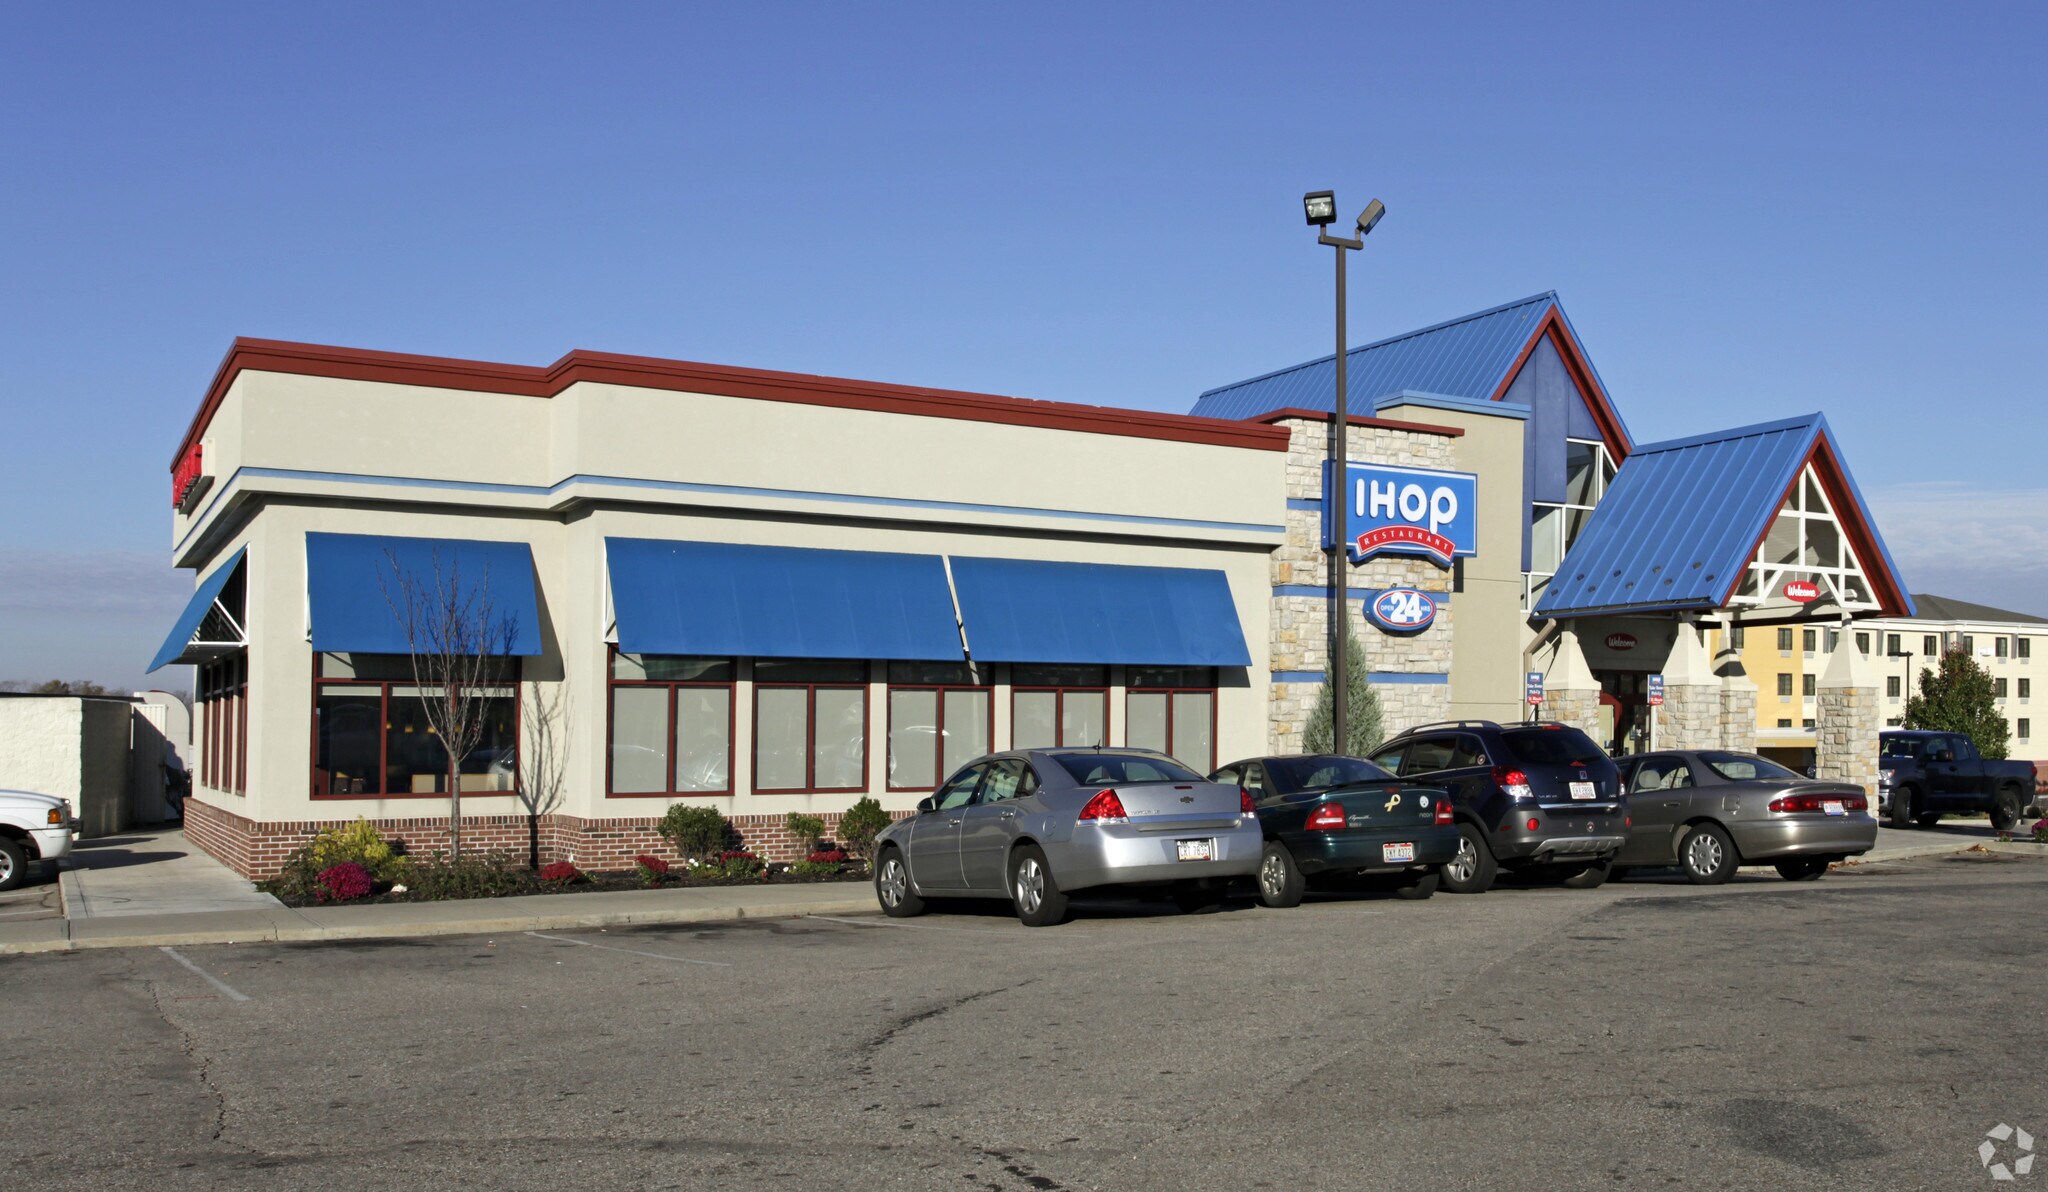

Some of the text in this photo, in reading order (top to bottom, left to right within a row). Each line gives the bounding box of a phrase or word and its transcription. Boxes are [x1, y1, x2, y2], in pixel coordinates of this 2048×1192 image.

[1363, 530, 1449, 551] RESTAURANT
[1787, 584, 1816, 598] Welcome
[1390, 592, 1422, 624] 24
[1608, 636, 1636, 647] Welcome
